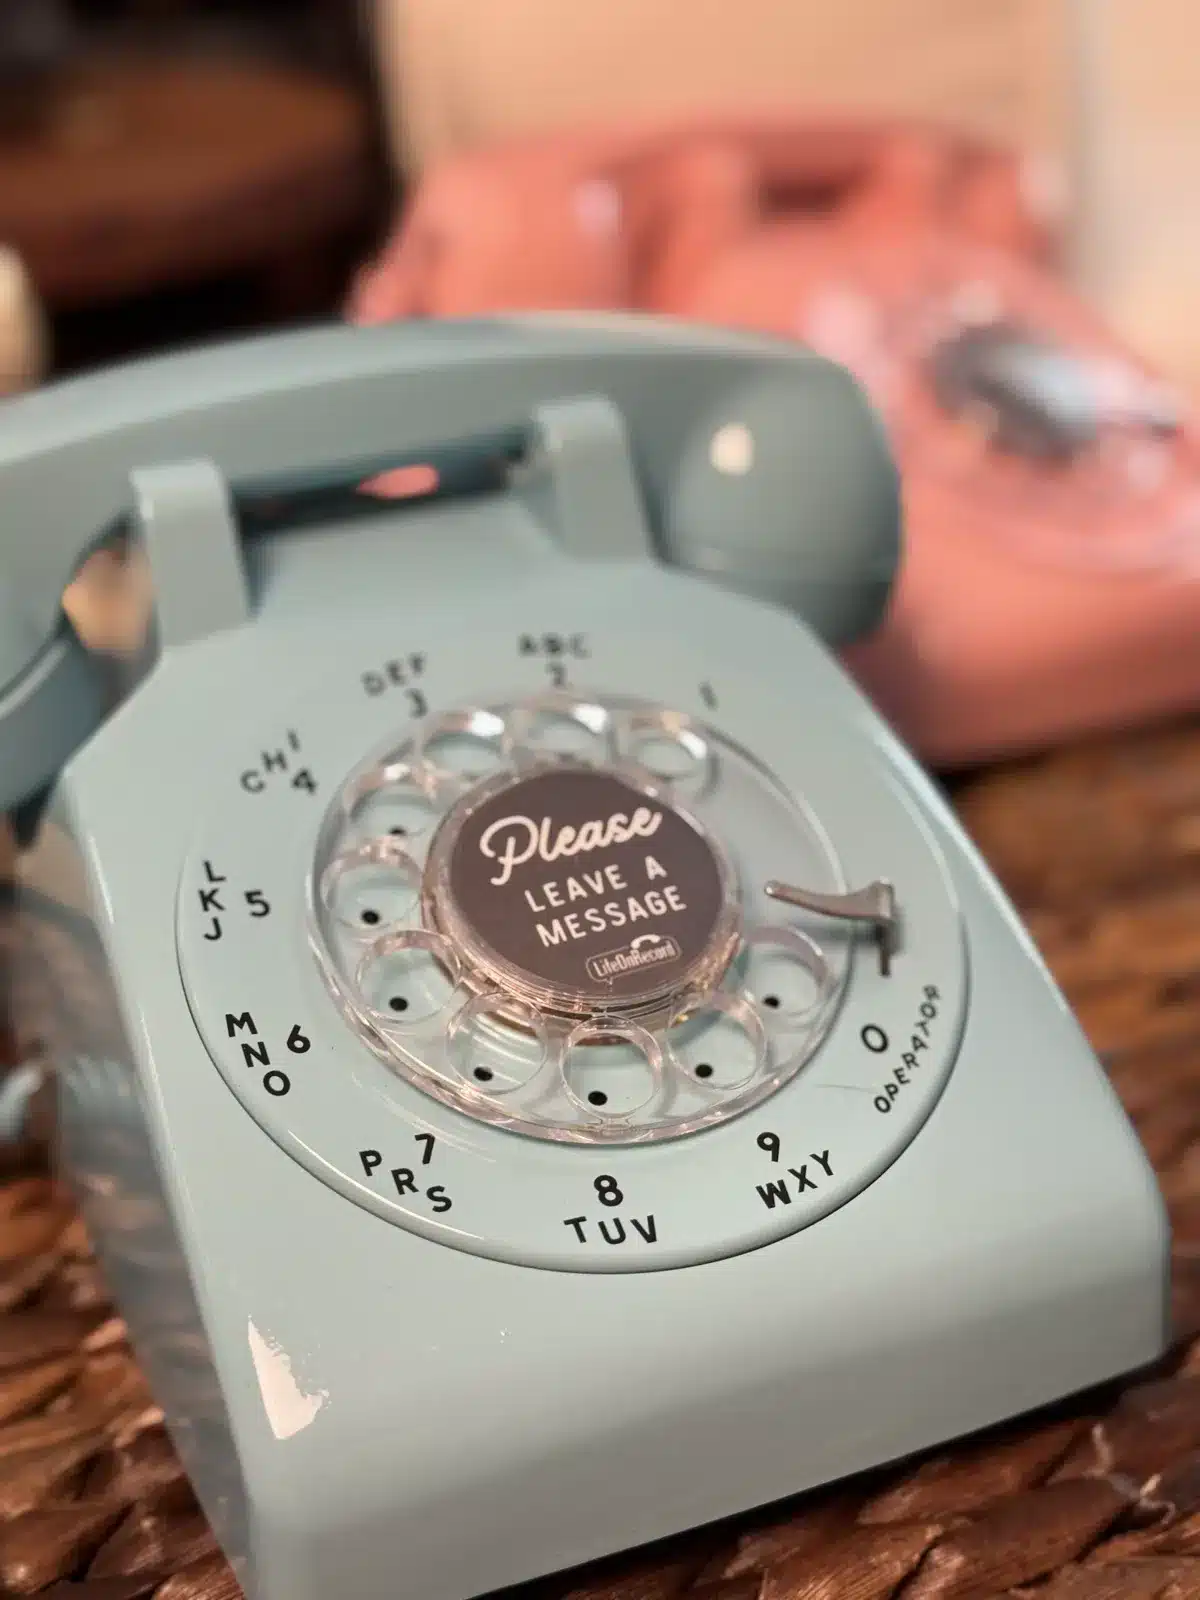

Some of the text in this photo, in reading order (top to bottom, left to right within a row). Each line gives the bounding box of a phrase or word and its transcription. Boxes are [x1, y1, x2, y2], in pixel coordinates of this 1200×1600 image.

[290, 767, 318, 795] 4
[479, 806, 663, 886] Please
[524, 855, 667, 913] LEAVE A
[244, 890, 271, 918] 5
[535, 885, 687, 948] MESSAGE
[592, 939, 677, 977] LifeOnRecord
[225, 1012, 291, 1097] MNO
[286, 1024, 311, 1054] 6
[873, 984, 941, 1114] OPERATOR
[414, 1132, 436, 1165] 7
[756, 1131, 781, 1163] 9
[358, 1149, 453, 1213] PRS
[593, 1174, 625, 1207] 8
[755, 1150, 834, 1209] WXY
[563, 1214, 658, 1245] TUV
